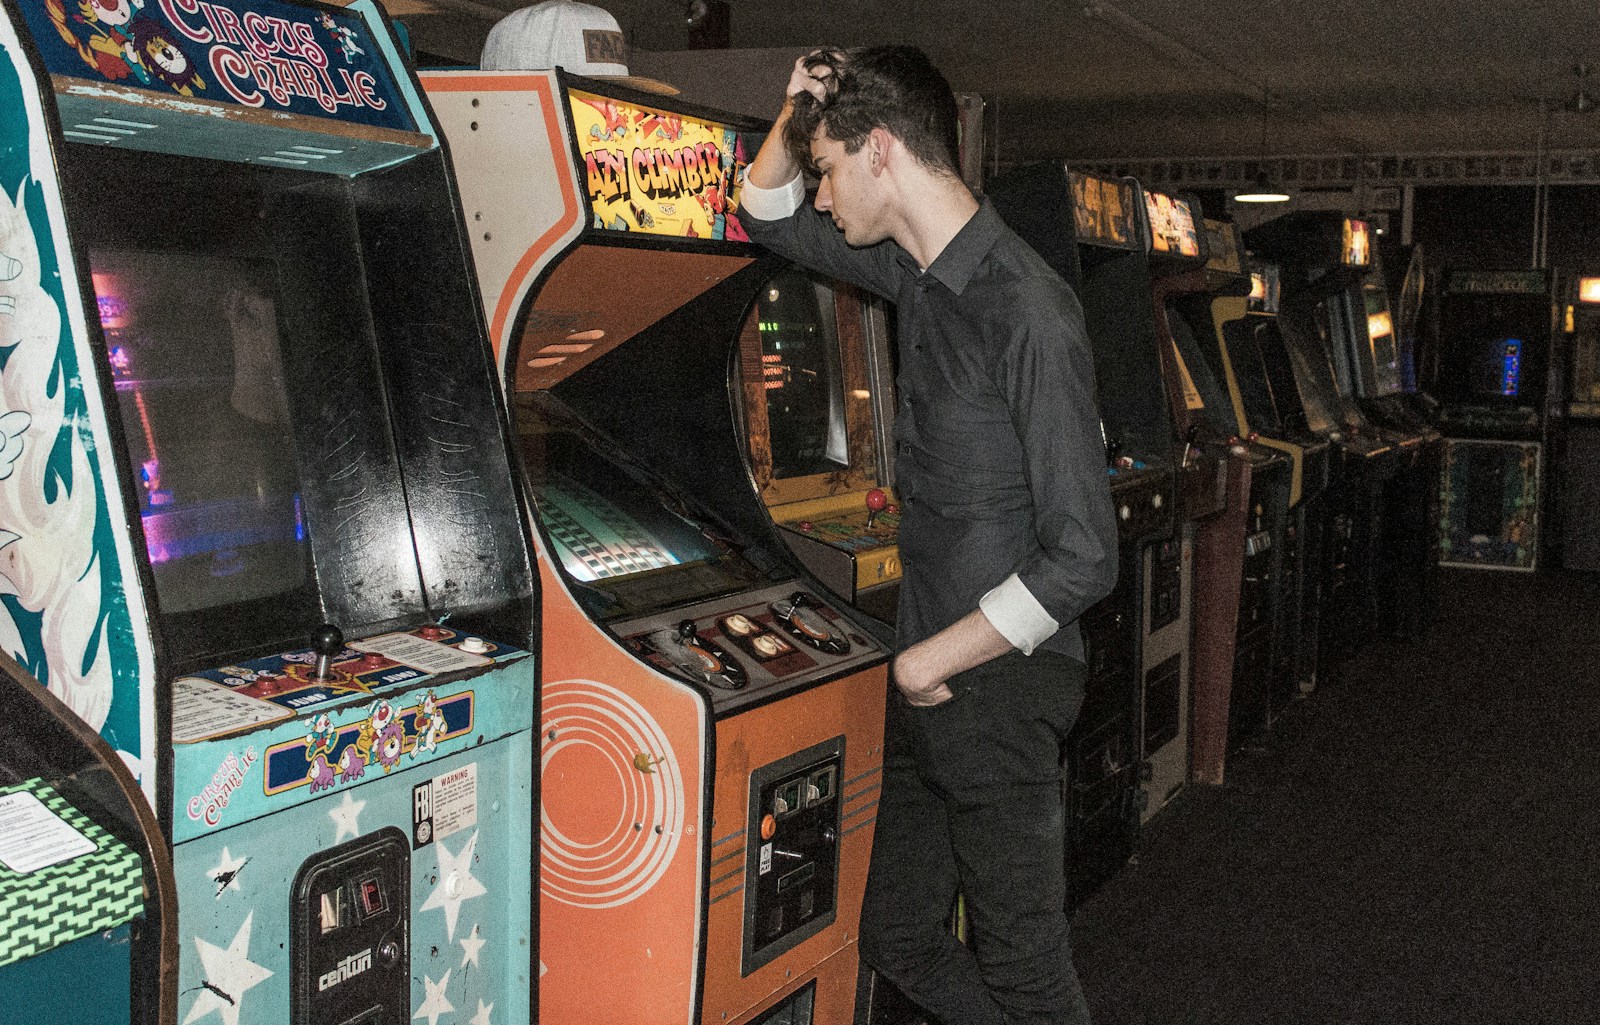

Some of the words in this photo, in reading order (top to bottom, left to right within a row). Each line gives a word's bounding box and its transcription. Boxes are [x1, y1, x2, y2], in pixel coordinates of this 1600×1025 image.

[159, 0, 328, 68] CIRCUS
[209, 45, 386, 113] CHARLIE
[632, 142, 726, 199] CLIMBER
[287, 692, 328, 708] JUMP
[381, 670, 418, 683] JUMP
[187, 751, 240, 821] CIRCUS
[204, 745, 258, 827] CHARLIE
[415, 783, 433, 823] FBI
[441, 769, 468, 787] WARNING
